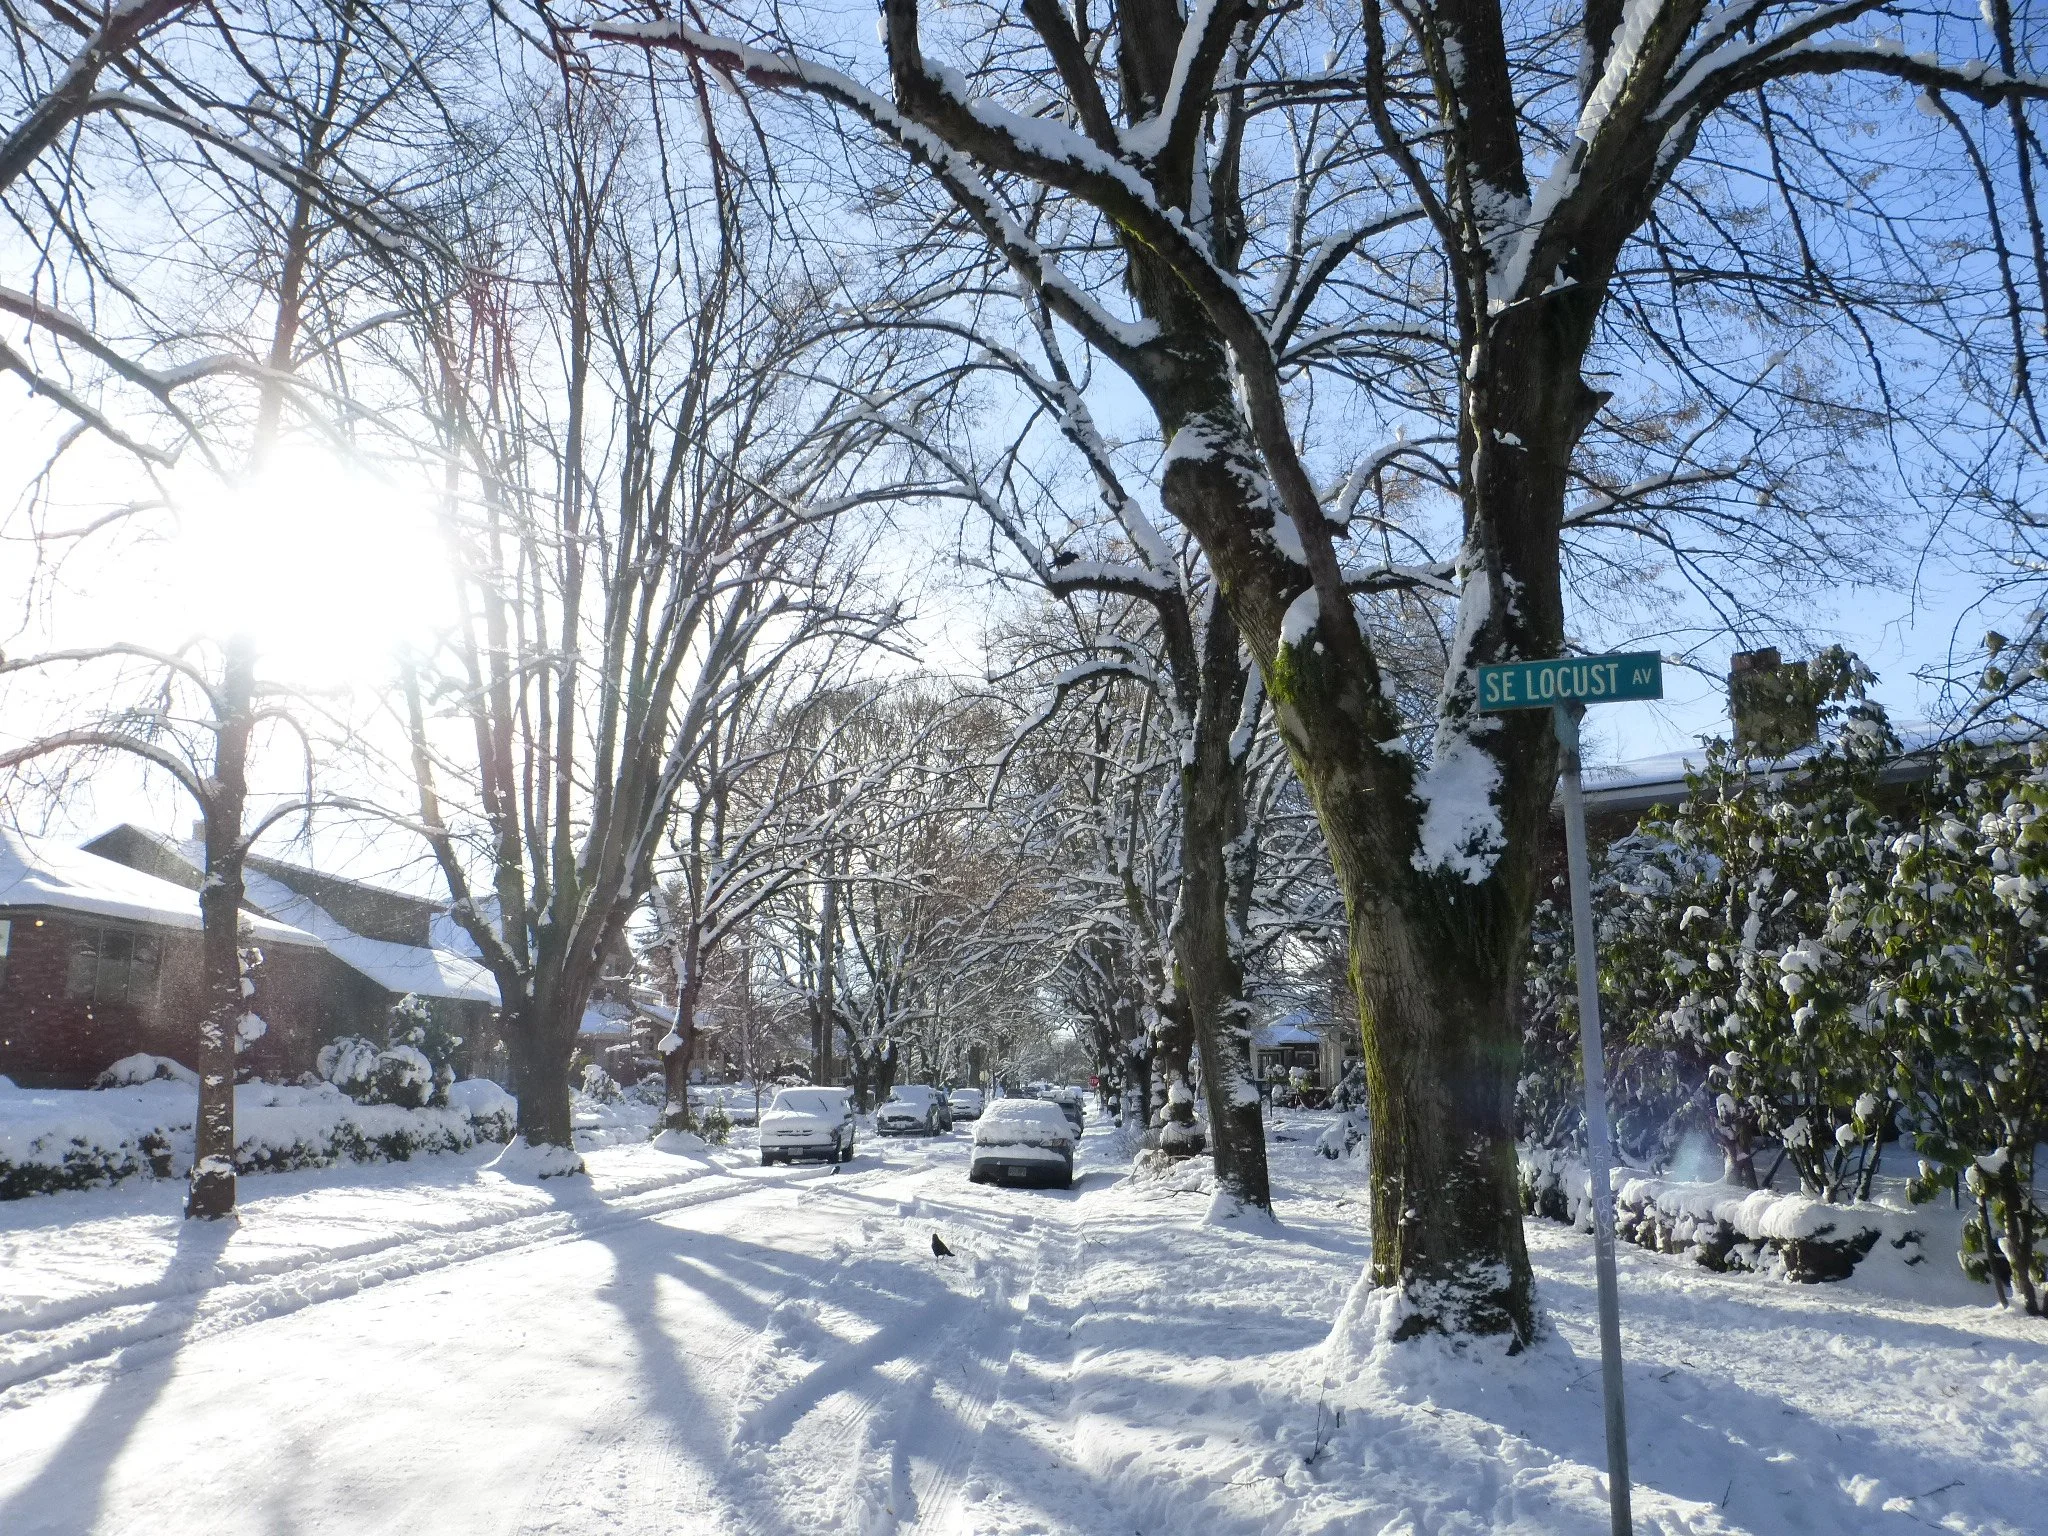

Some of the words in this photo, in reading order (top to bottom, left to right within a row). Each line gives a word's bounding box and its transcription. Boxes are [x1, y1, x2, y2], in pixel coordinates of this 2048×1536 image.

[1486, 671, 1516, 703] SE
[1526, 663, 1619, 700] LOCUST
[1632, 668, 1652, 685] AV
